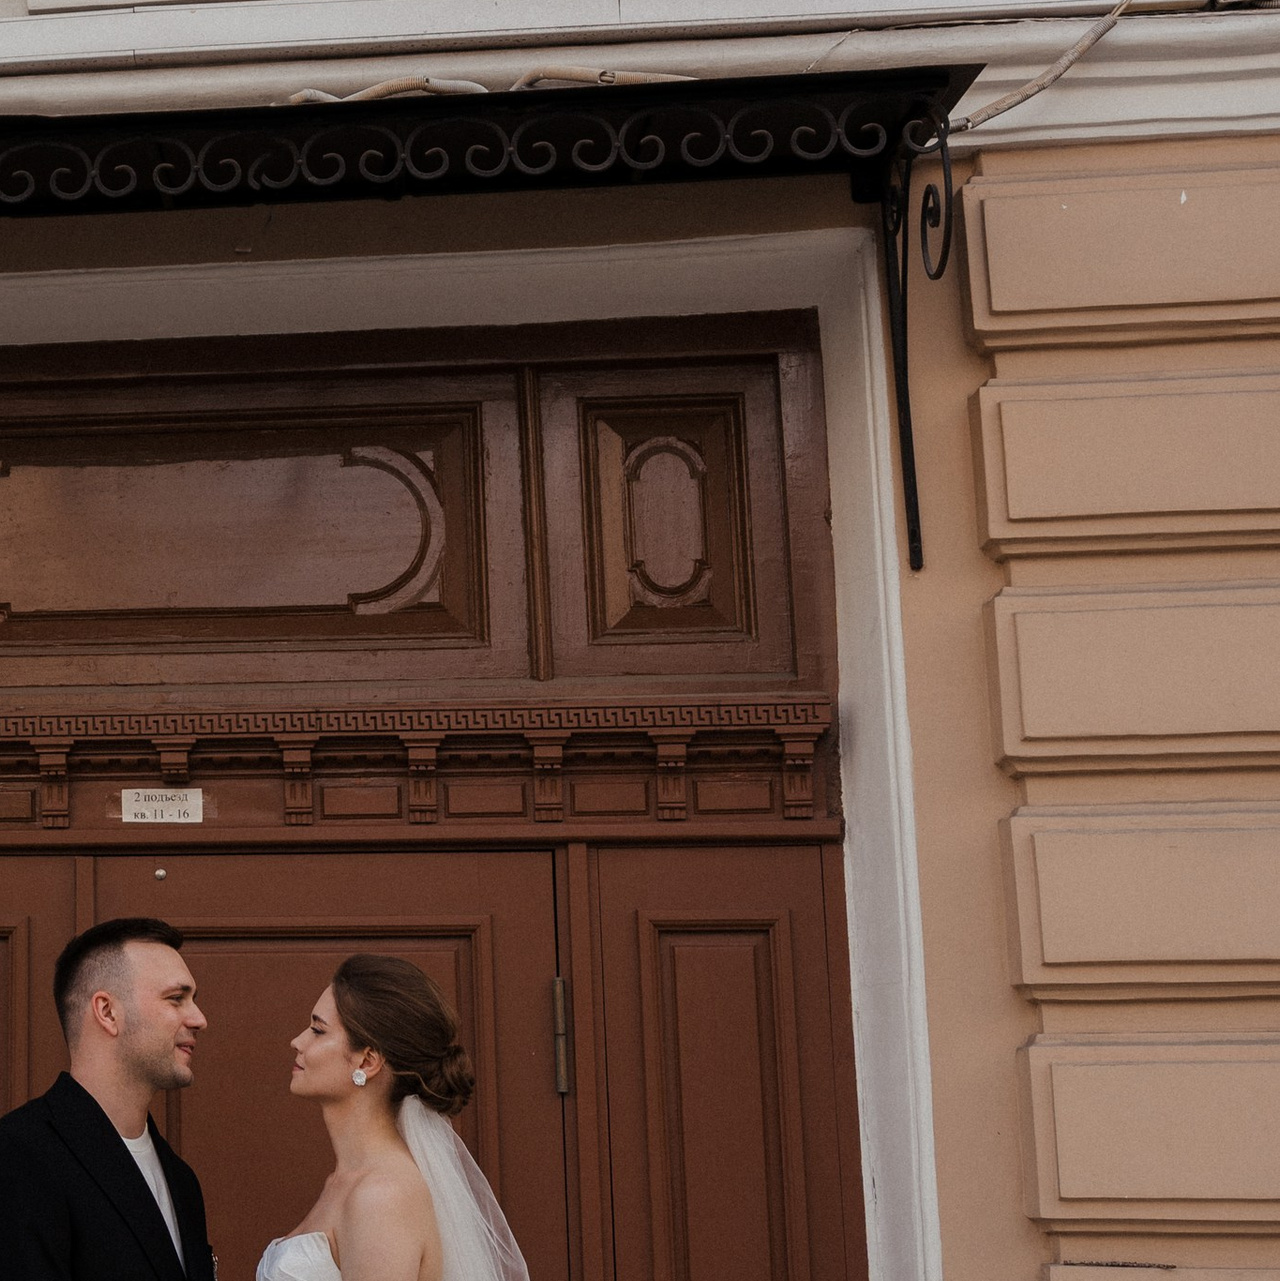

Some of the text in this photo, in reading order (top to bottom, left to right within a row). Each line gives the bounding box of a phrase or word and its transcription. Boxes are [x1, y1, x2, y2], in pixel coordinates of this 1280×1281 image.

[134, 792, 189, 803] 2 подъезд
[133, 811, 149, 820] кв.
[153, 809, 164, 819] 11
[177, 809, 190, 819] 16
